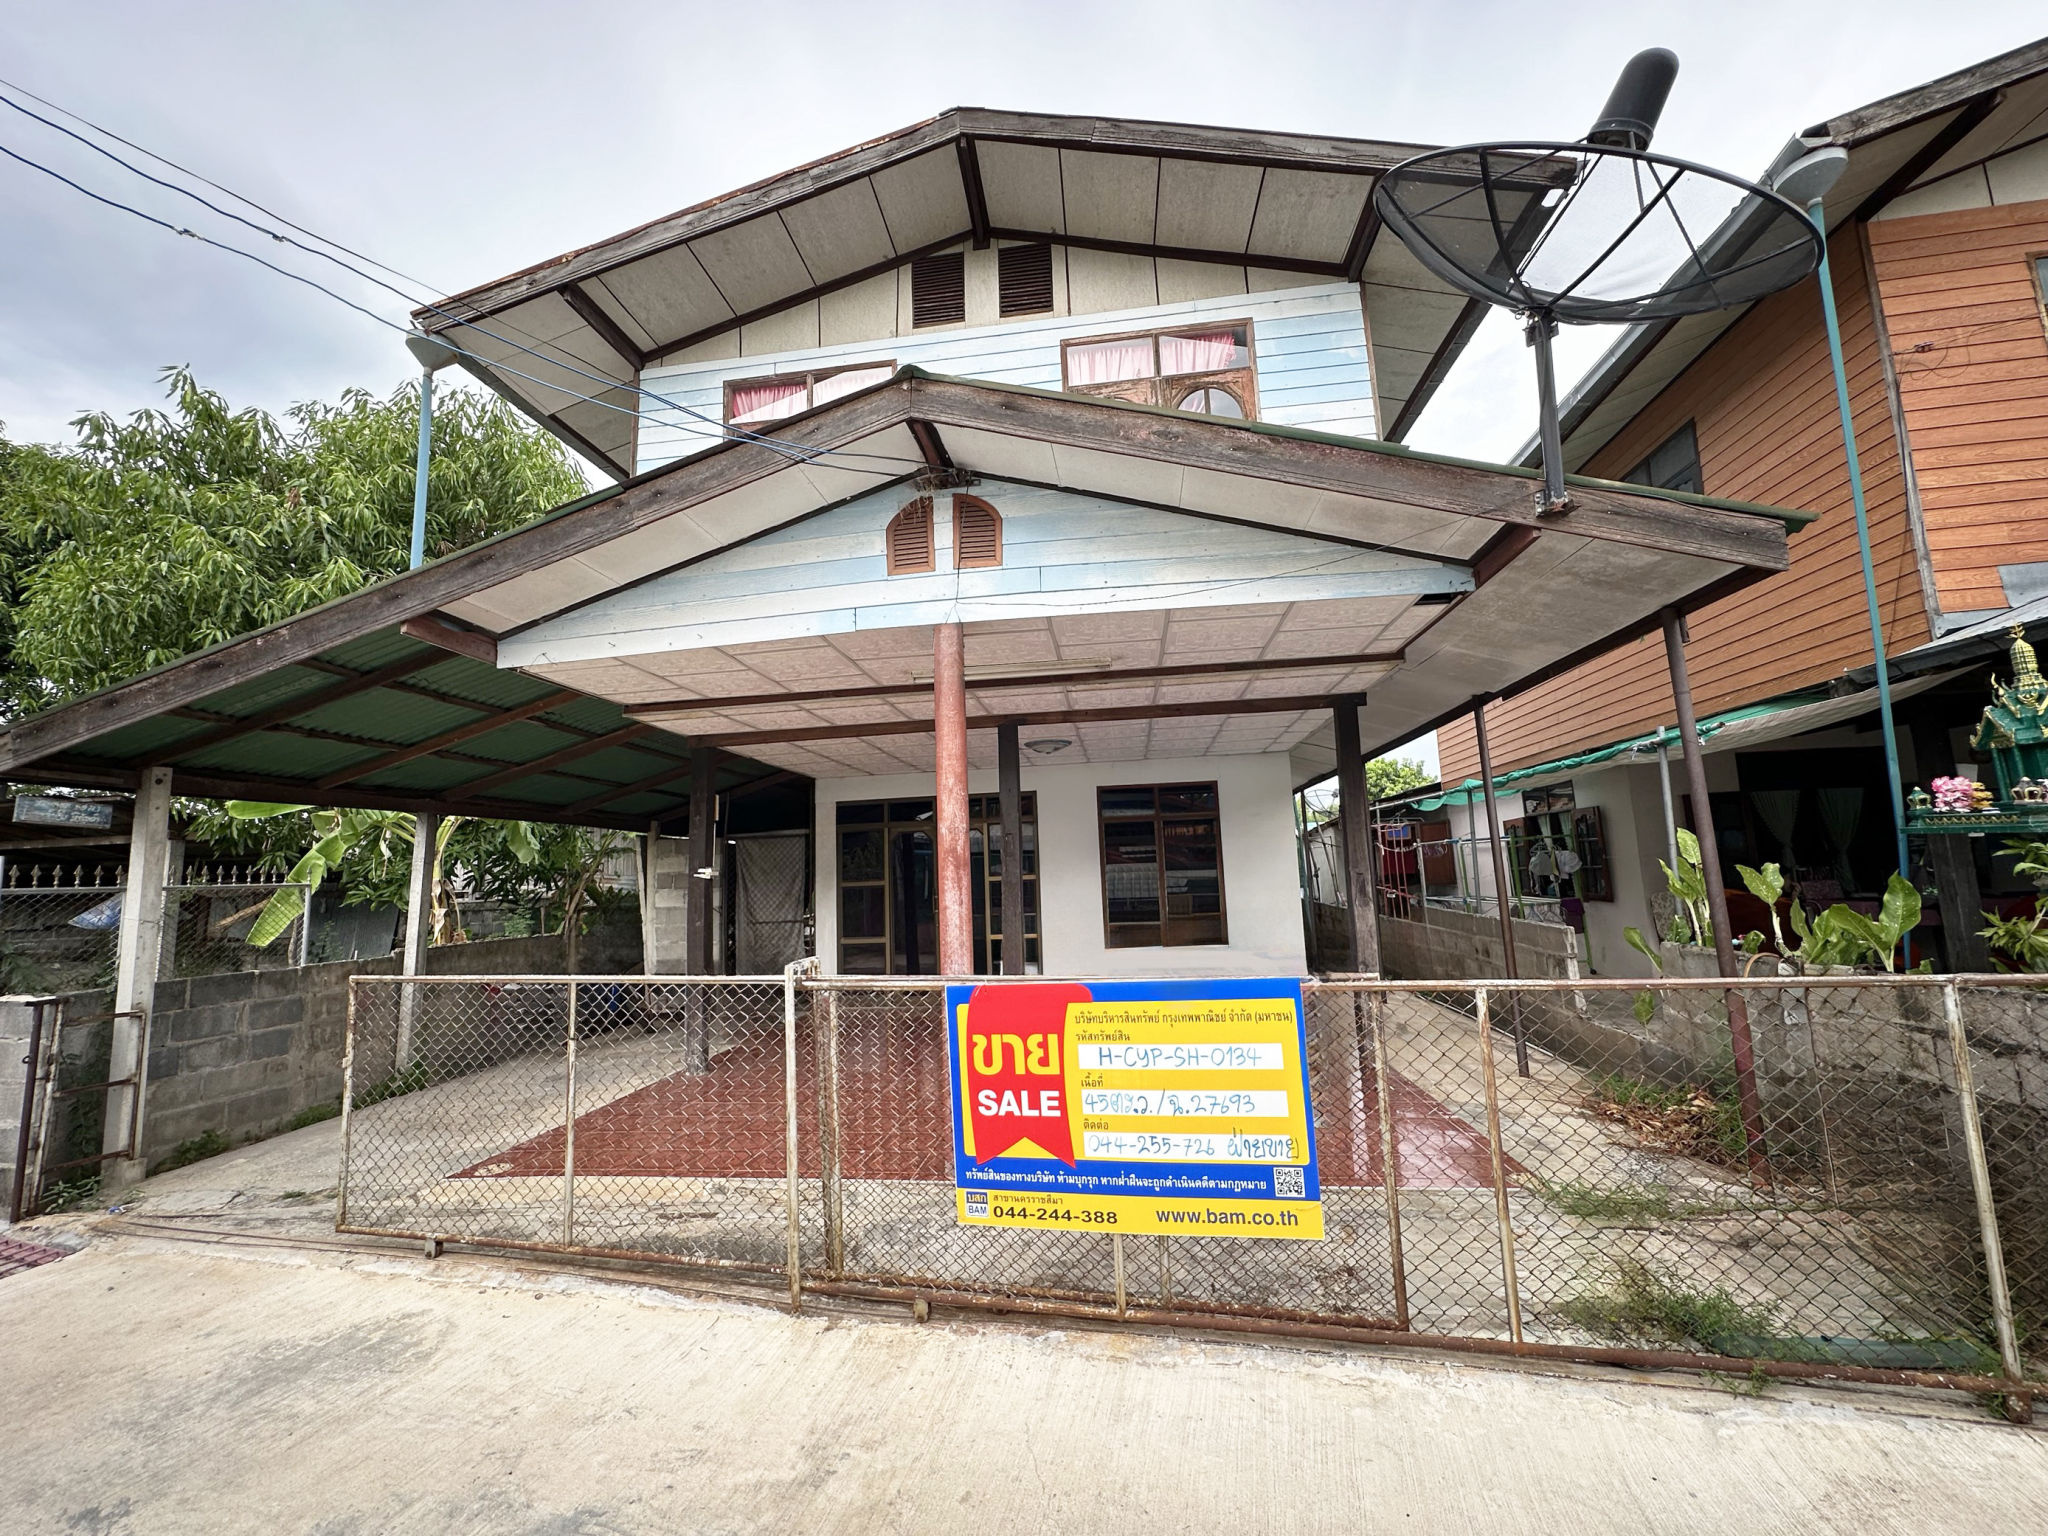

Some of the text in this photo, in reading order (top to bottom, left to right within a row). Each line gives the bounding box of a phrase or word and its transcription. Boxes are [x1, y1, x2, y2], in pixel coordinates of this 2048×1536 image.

[1075, 1008, 1293, 1028] บริษัทบริหารสินทรัพย์ กรุงเทพพาณิชย์ จำกัด (มหาชน)
[1076, 1030, 1130, 1041] รหัสทรัพย์สิน
[972, 1033, 1060, 1075] ขาย
[1081, 1072, 1103, 1087] เนื้อที่
[978, 1089, 1061, 1117] SALE
[1084, 1118, 1109, 1130] ติดต่อ
[966, 1168, 1056, 1183] ทรัพย์สินของทางบริษัท
[1058, 1171, 1098, 1189] ห้ามบุกรุก
[993, 1193, 1063, 1205] สาขานครราชสีมา
[968, 1205, 987, 1215] BAM
[993, 1205, 1118, 1224] 044-244-388
[1156, 1208, 1298, 1226] www.bam.co.th
